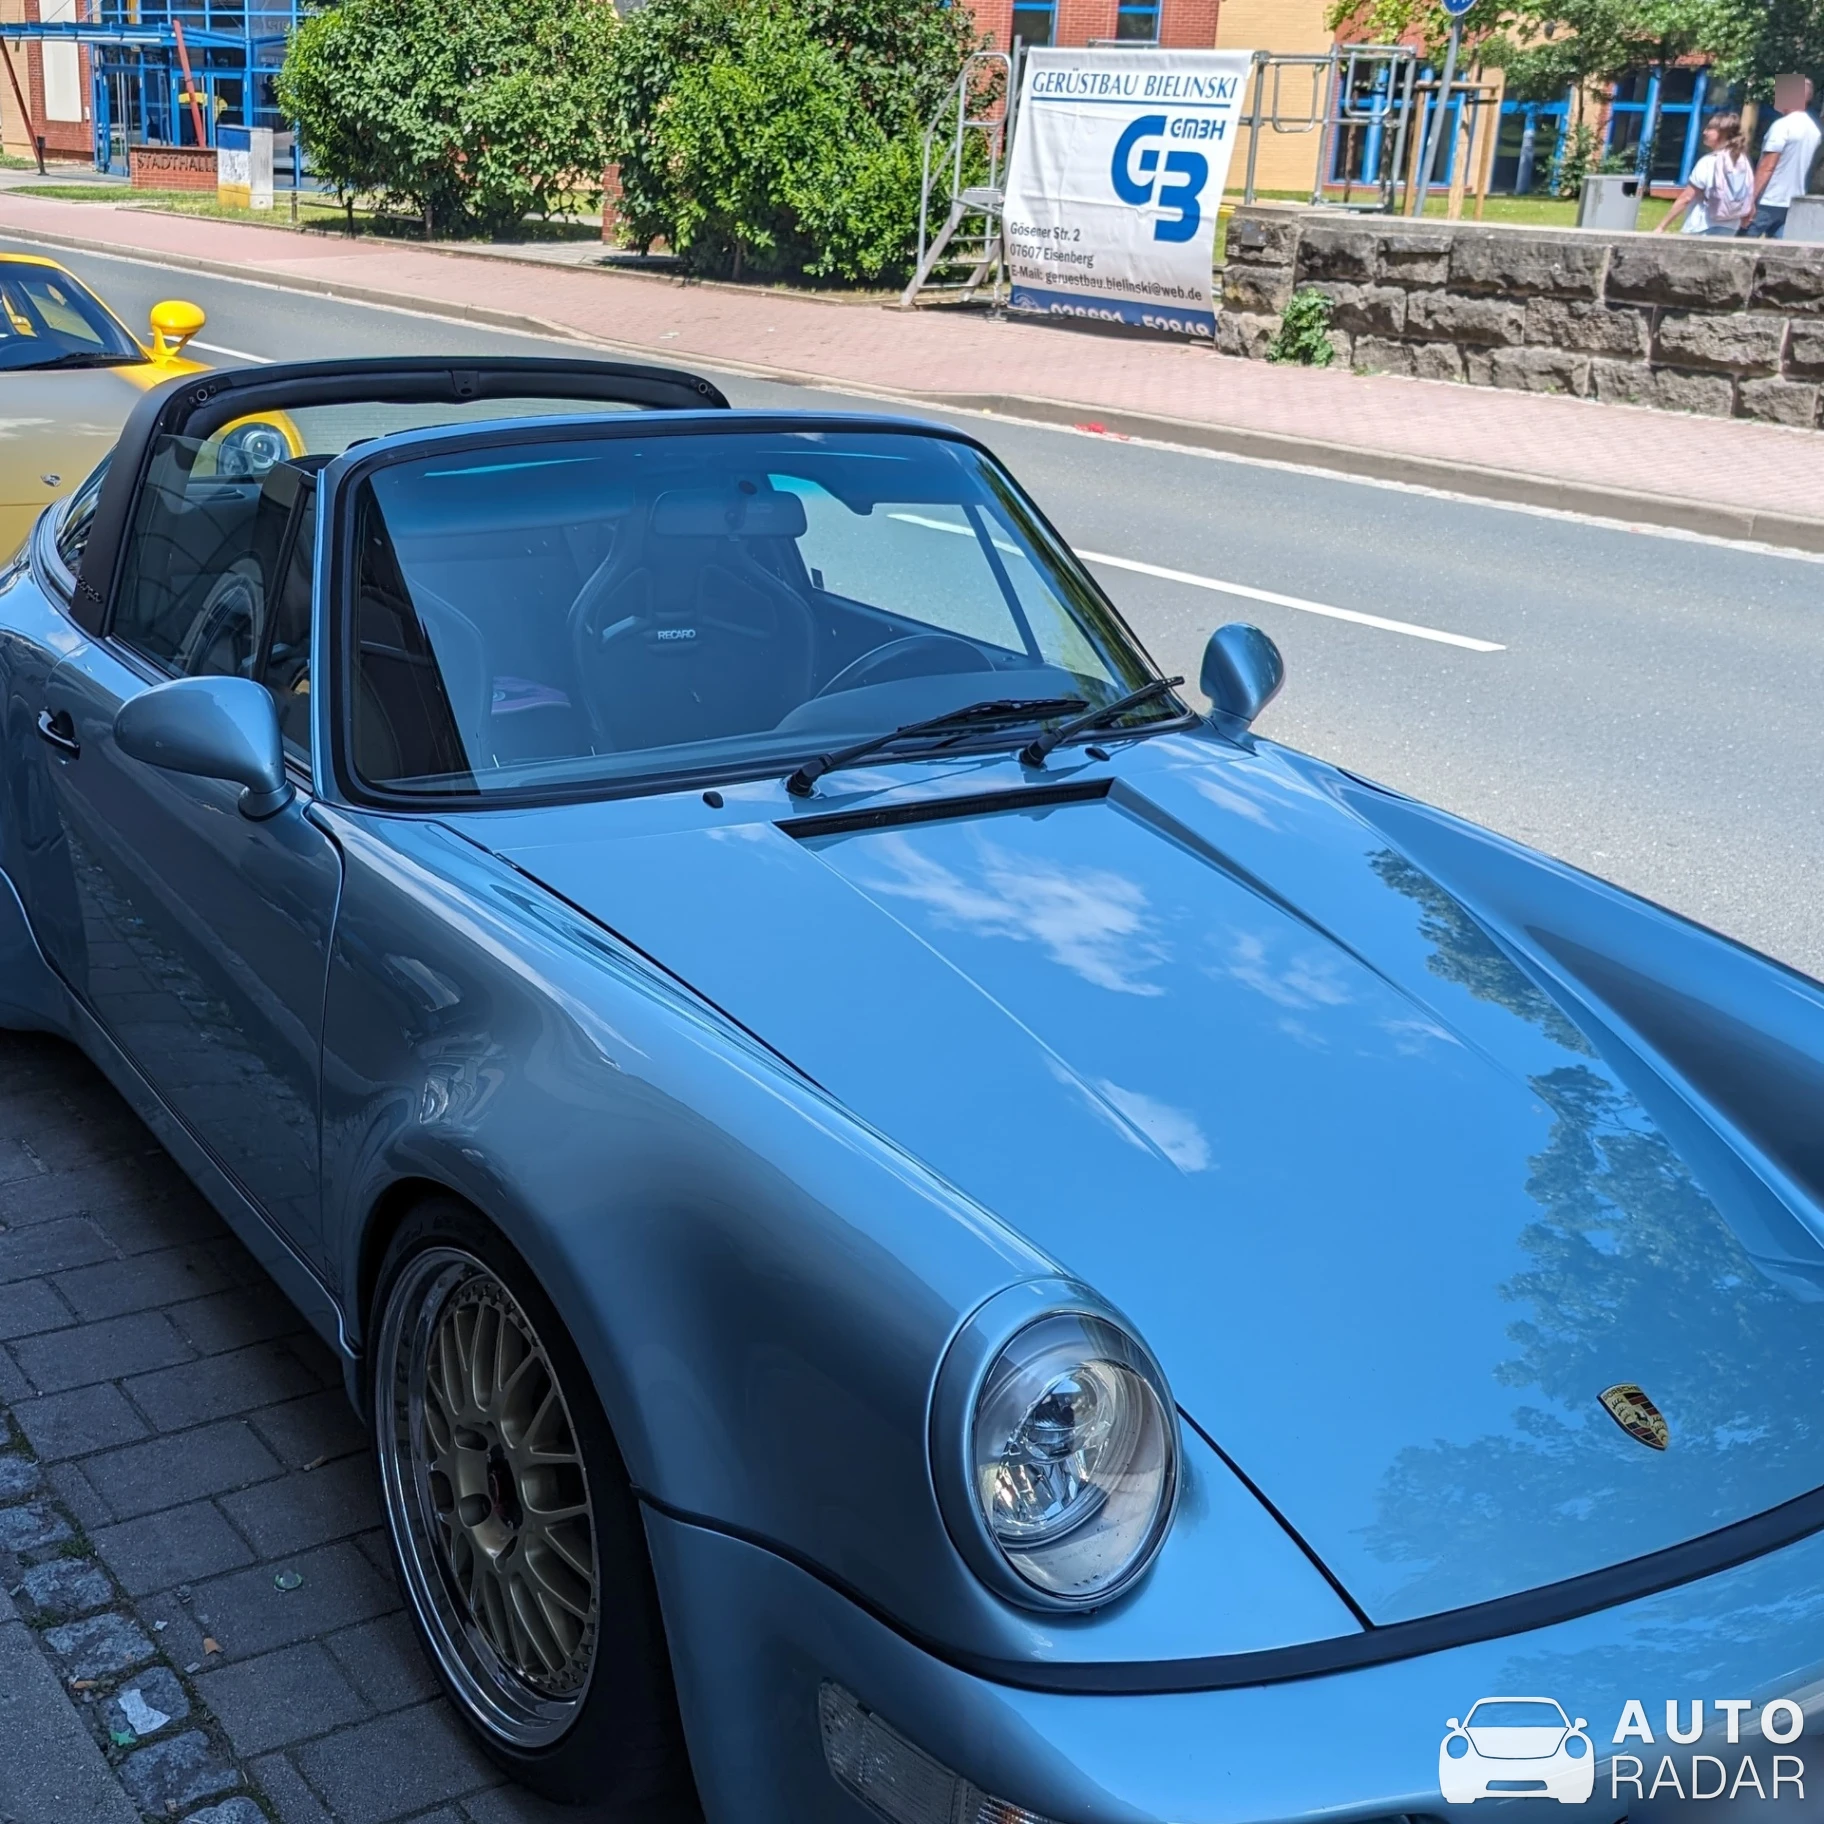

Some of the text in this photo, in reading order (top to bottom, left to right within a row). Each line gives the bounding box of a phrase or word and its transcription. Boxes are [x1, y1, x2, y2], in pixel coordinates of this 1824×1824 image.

[1032, 67, 1238, 99] GERÜSTBAU BIELINSKI
[1010, 222, 1081, 242] Gösener Str. 2
[1010, 243, 1094, 269] 07607 Eisenberg
[1011, 264, 1203, 301] E-Mail: geruestbau.bielinski@web.de
[657, 629, 696, 640] RECARO
[1602, 1386, 1640, 1401] PORSCHE
